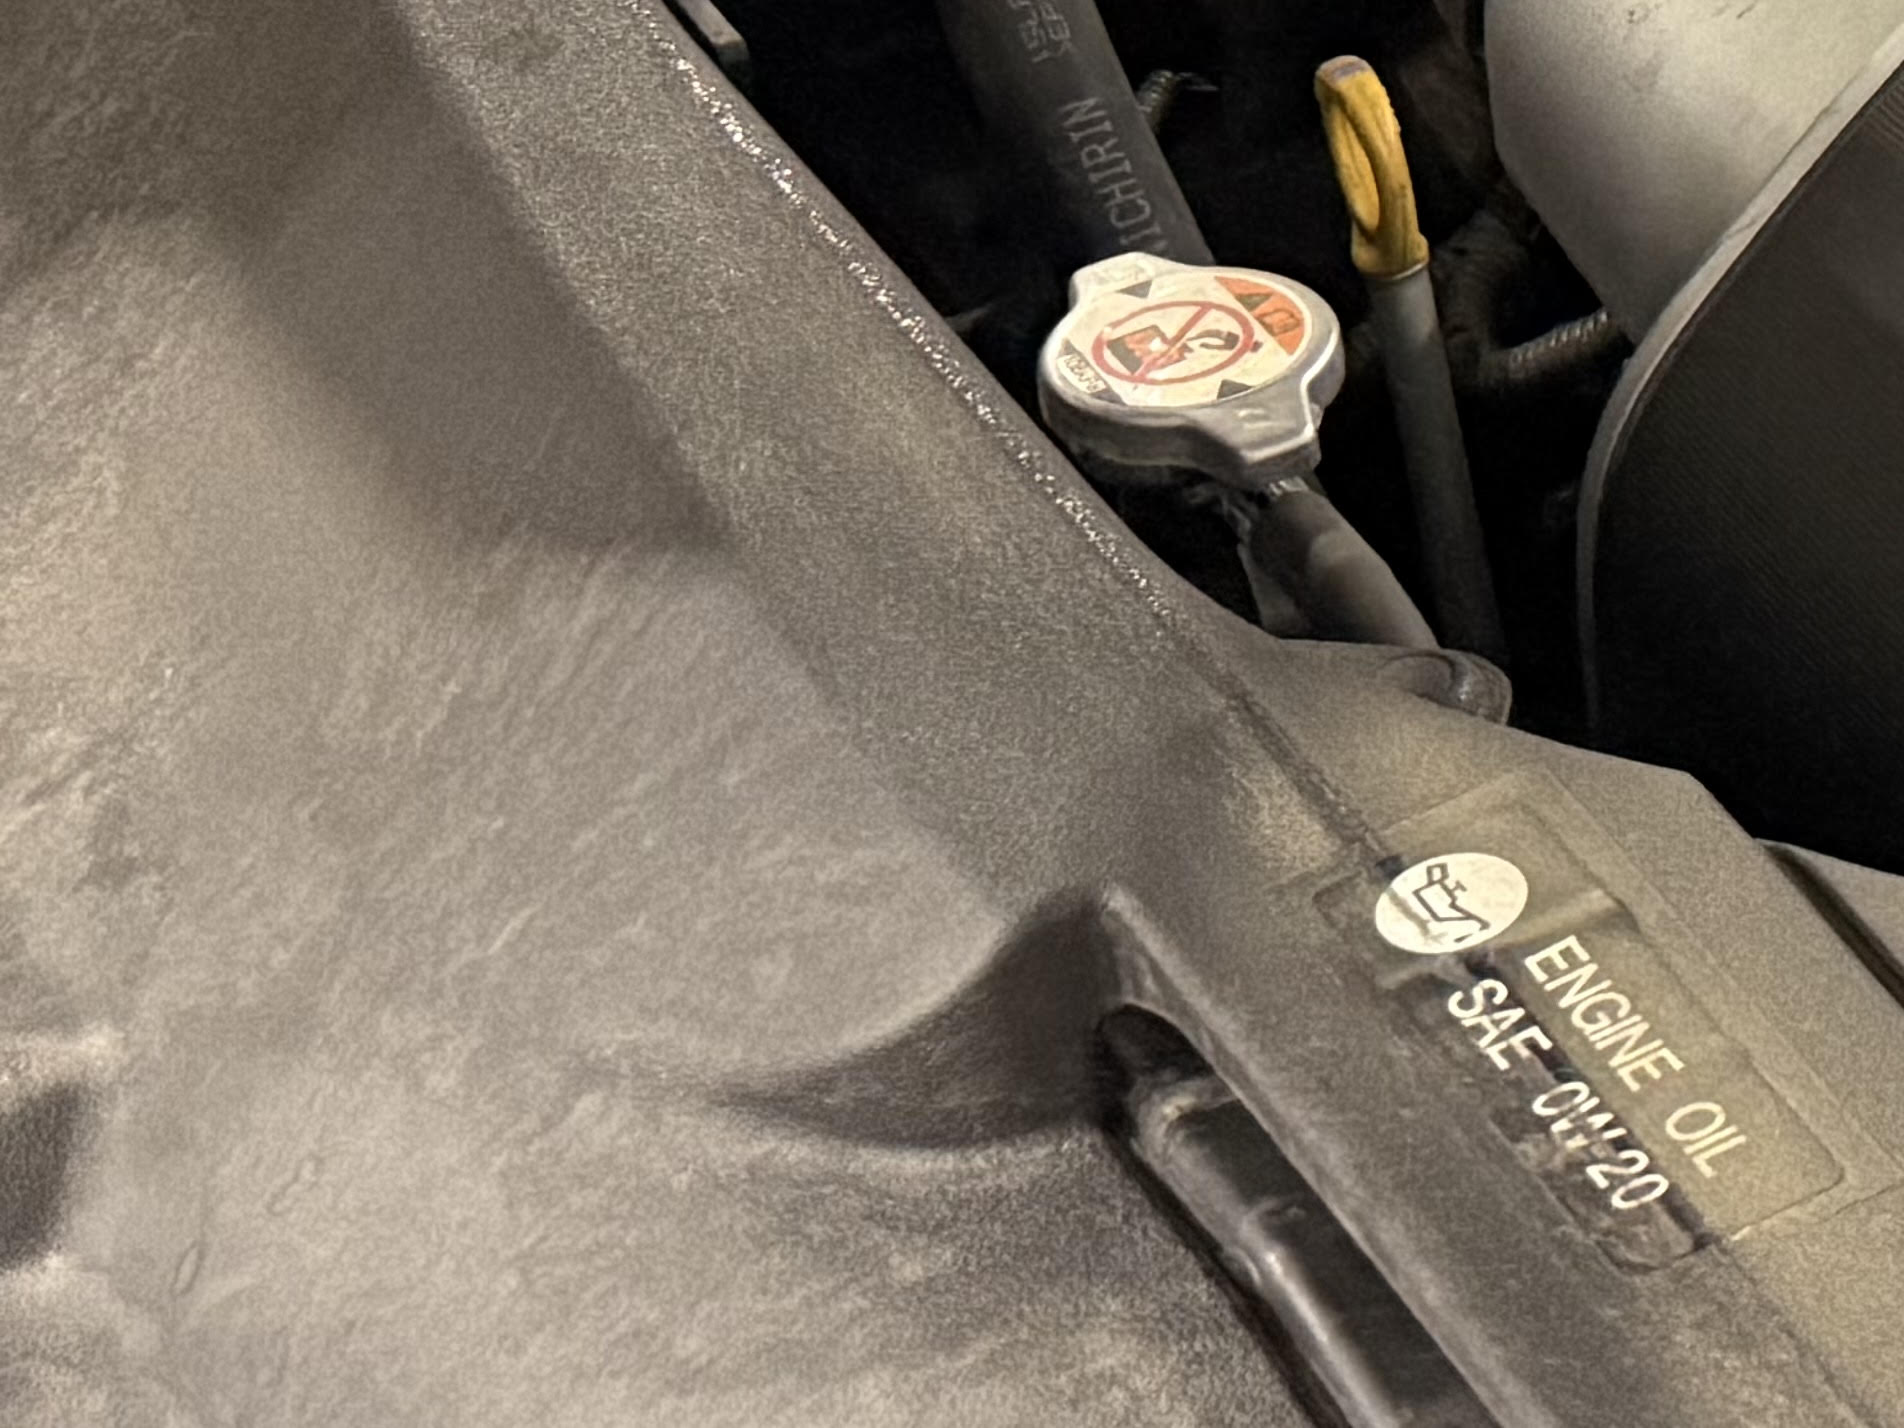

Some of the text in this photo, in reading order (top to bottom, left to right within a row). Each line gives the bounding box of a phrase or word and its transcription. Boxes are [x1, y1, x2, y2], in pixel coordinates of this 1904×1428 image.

[1448, 979, 1552, 1070] SAE
[1524, 935, 1748, 1177] ENGINE OIL
